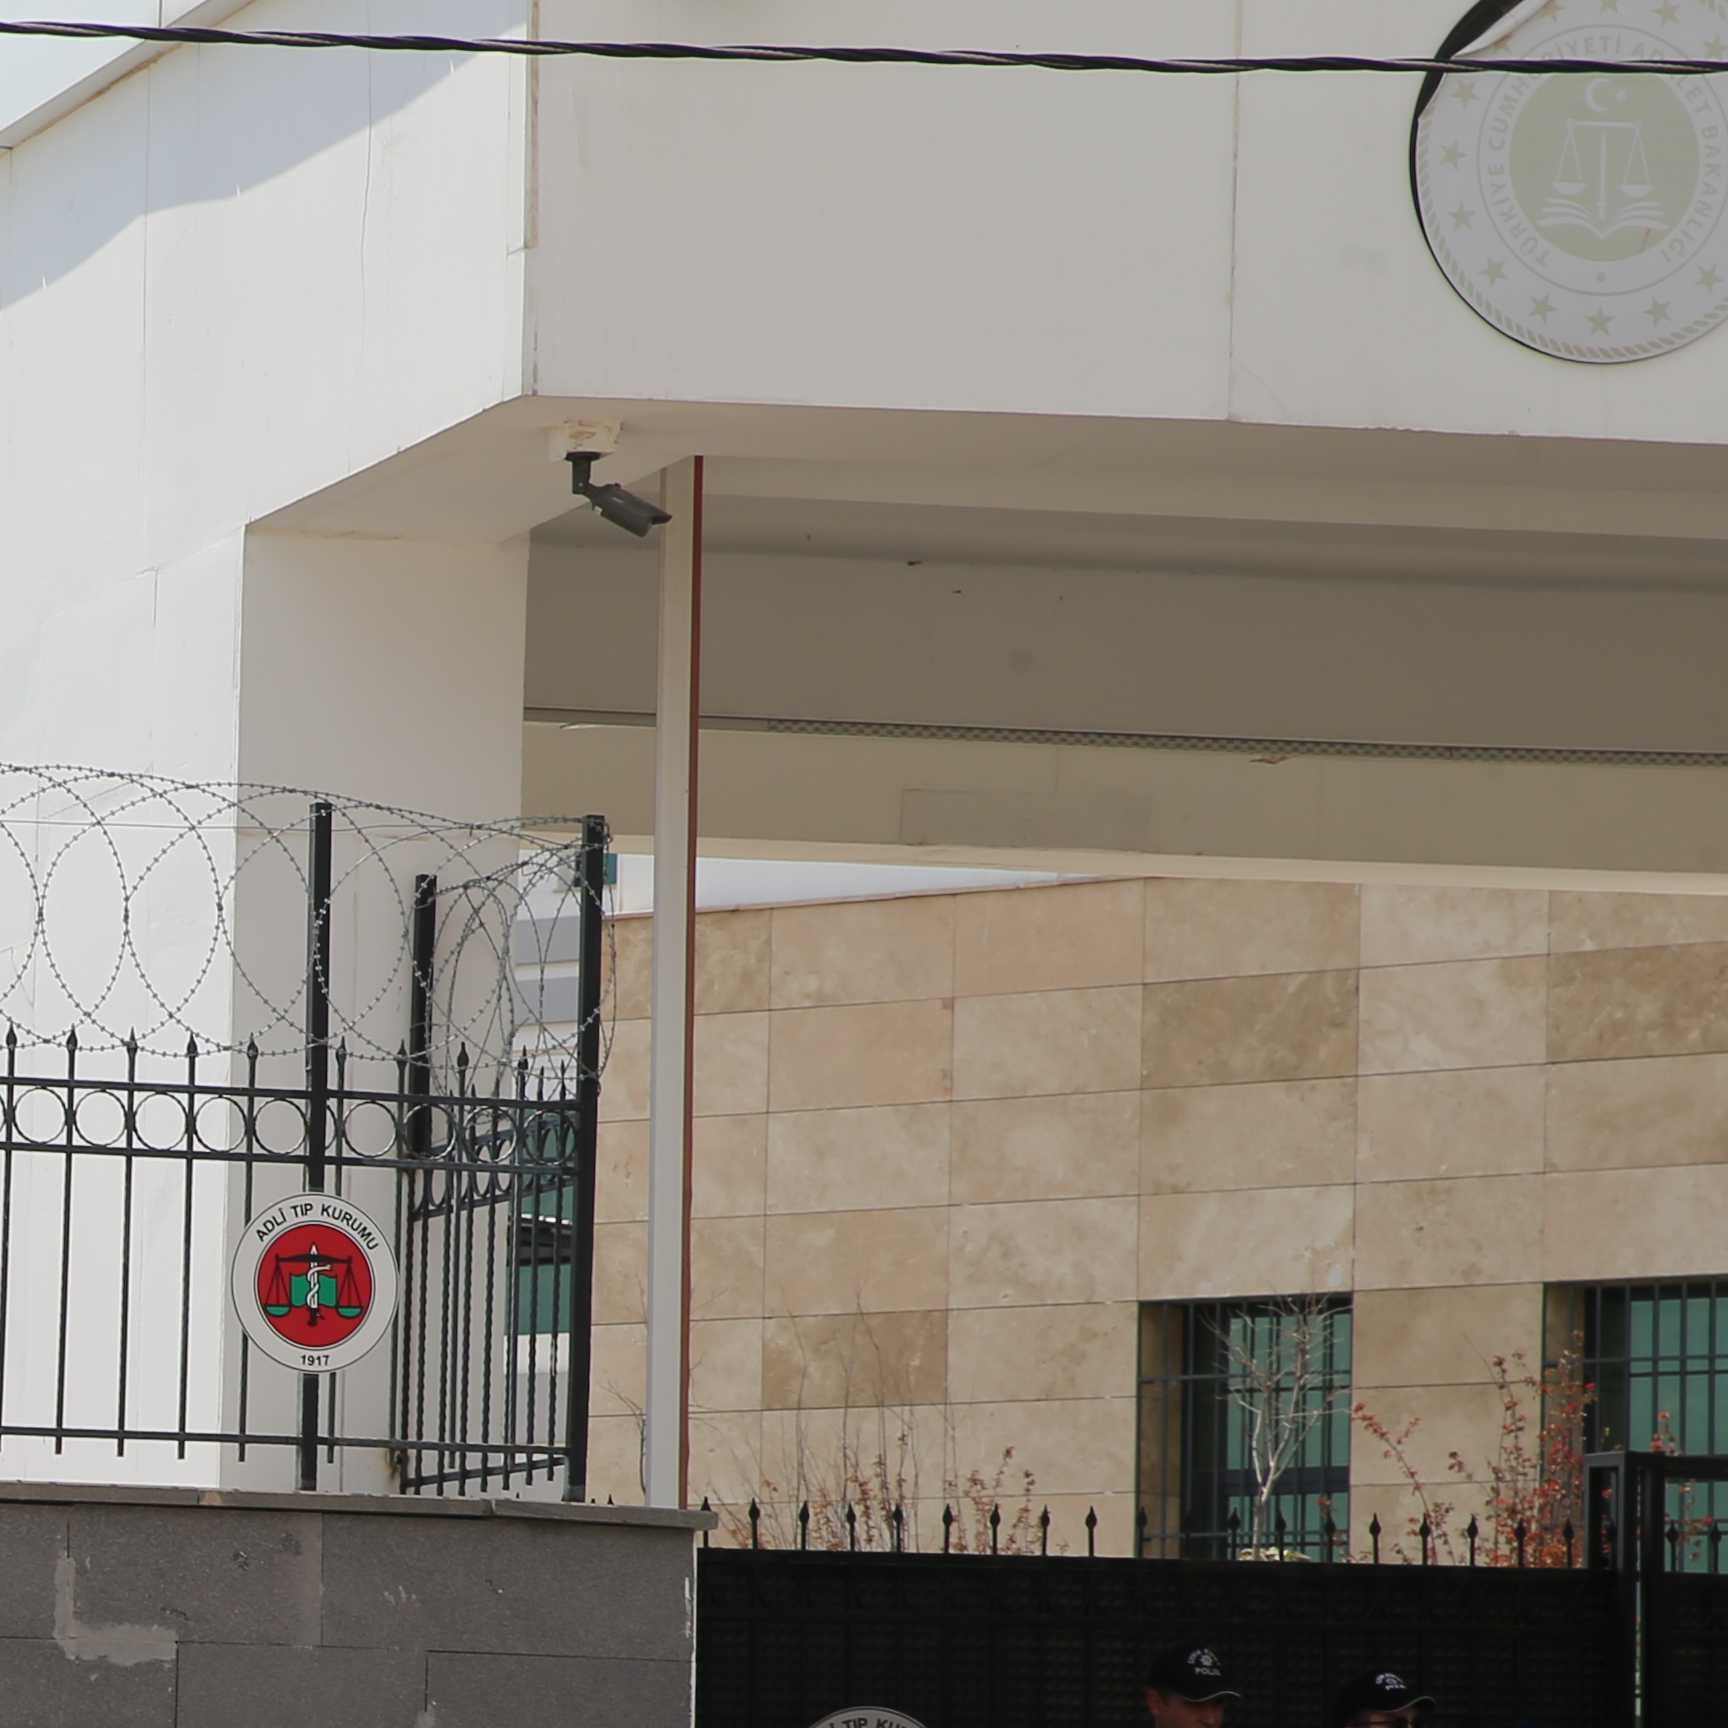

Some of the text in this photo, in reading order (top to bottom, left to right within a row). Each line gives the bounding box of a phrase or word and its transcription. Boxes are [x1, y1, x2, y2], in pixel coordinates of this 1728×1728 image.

[255, 1202, 379, 1251] ADLİ TIP KURUMU
[301, 1355, 329, 1366] 1917
